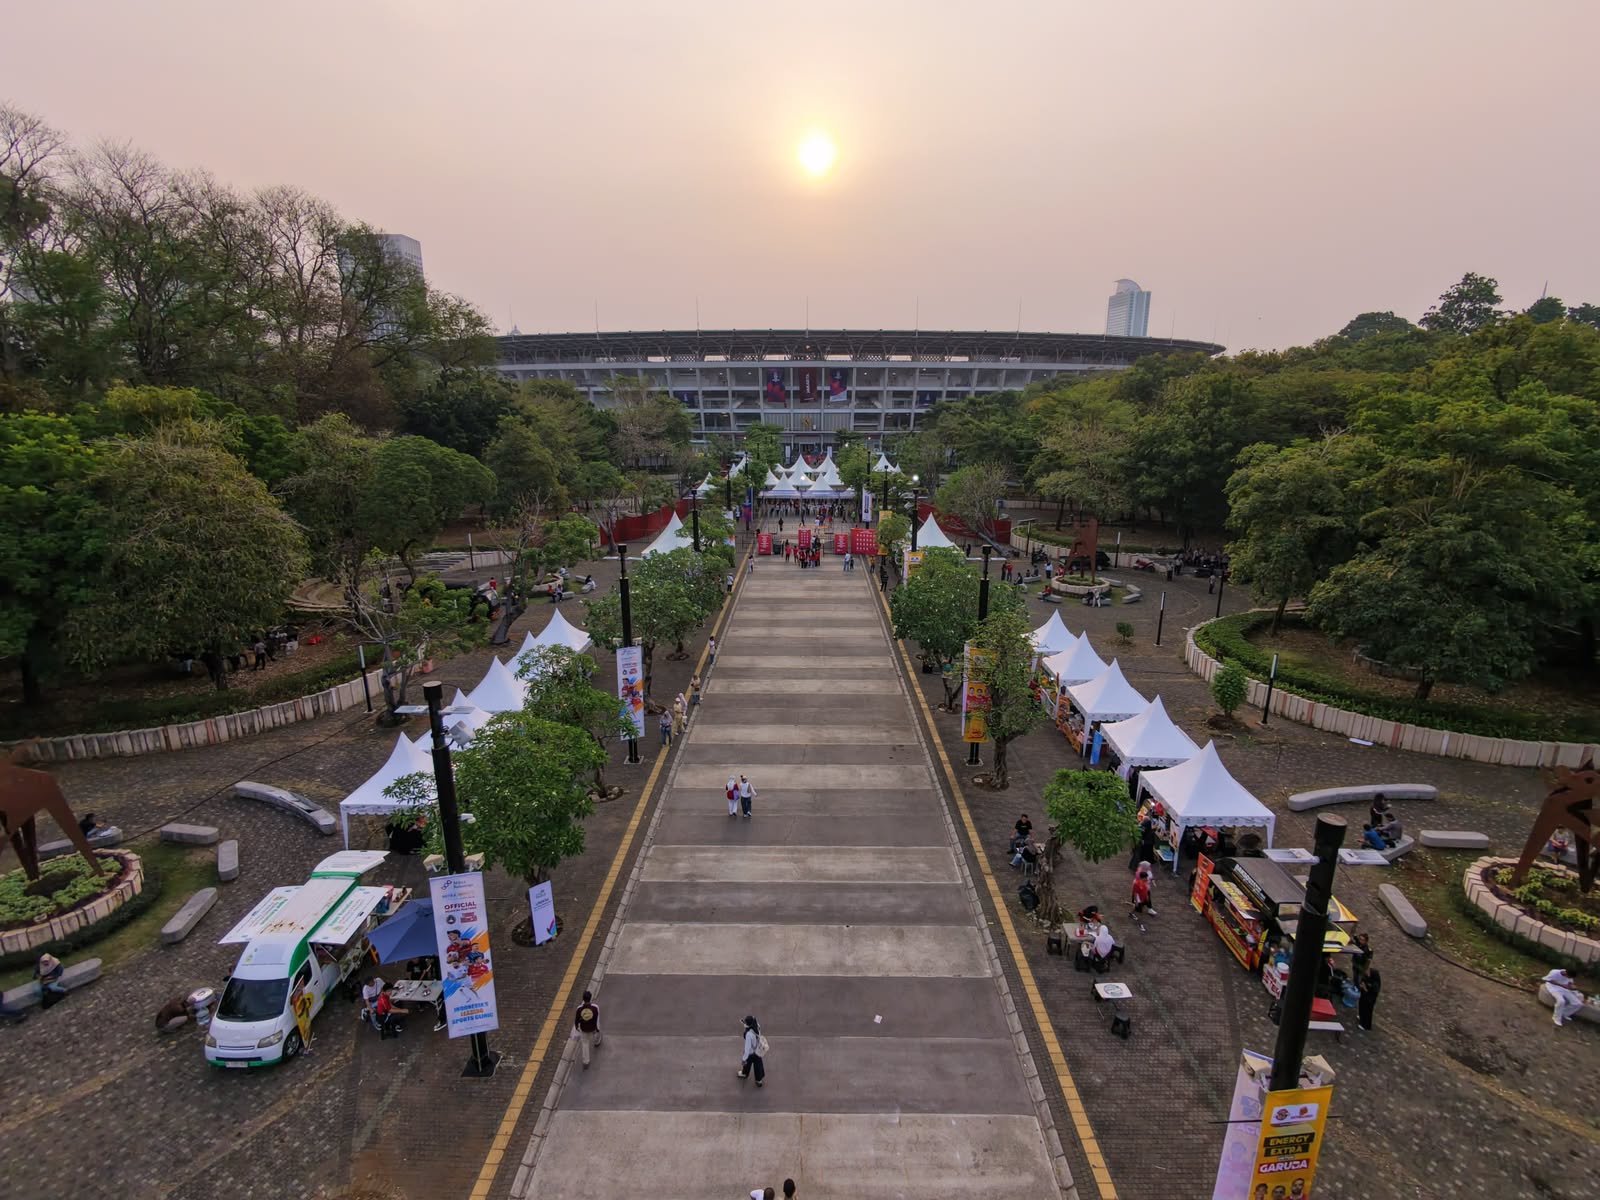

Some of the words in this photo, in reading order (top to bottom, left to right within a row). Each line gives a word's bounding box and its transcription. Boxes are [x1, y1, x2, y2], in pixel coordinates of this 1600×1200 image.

[444, 901, 477, 910] OFFICIAL
[1270, 1135, 1310, 1145] ENERGY
[1270, 1146, 1302, 1155] EXTRA
[1260, 1160, 1308, 1173] GARUDA
